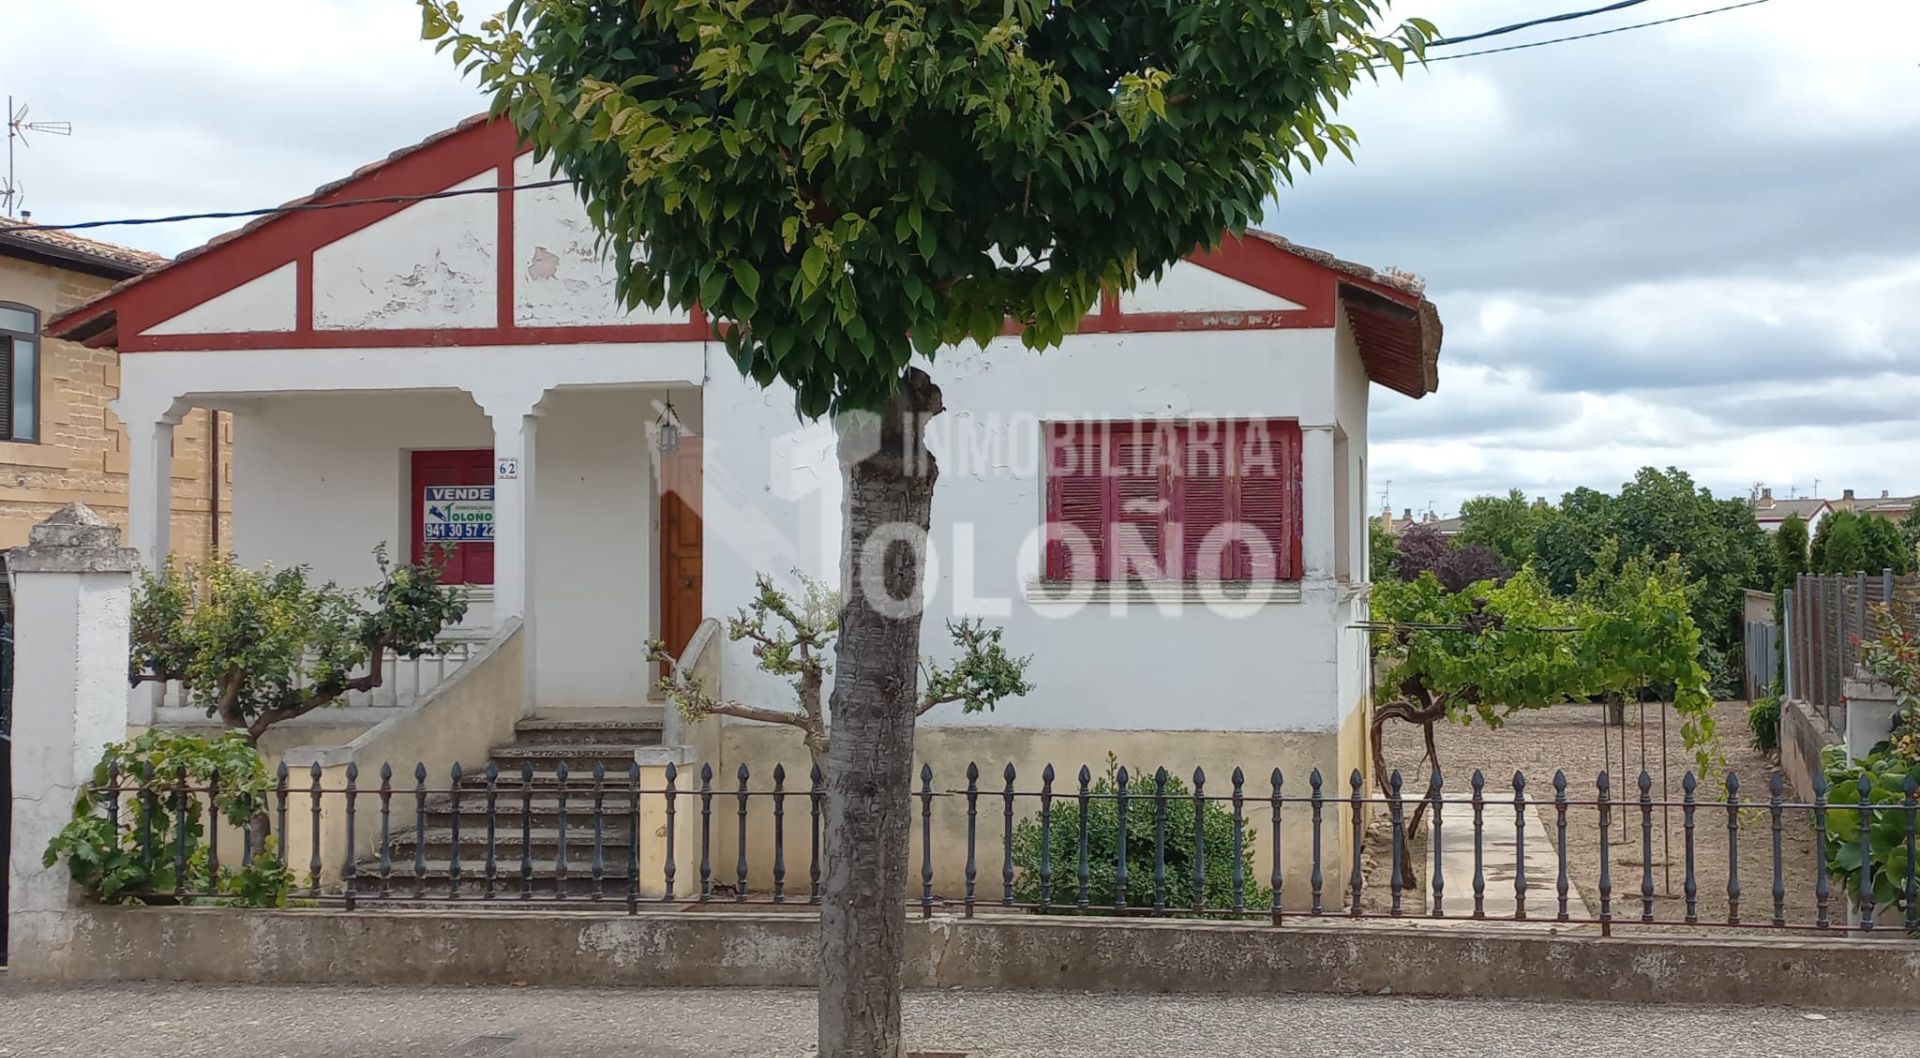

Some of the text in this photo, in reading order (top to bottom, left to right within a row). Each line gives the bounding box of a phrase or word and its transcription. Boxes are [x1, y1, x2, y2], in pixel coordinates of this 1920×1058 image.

[499, 463, 516, 474] 62
[432, 489, 491, 500] VENDE
[444, 502, 493, 522] TOLOÑO
[426, 524, 495, 537] 941 30 57 22
